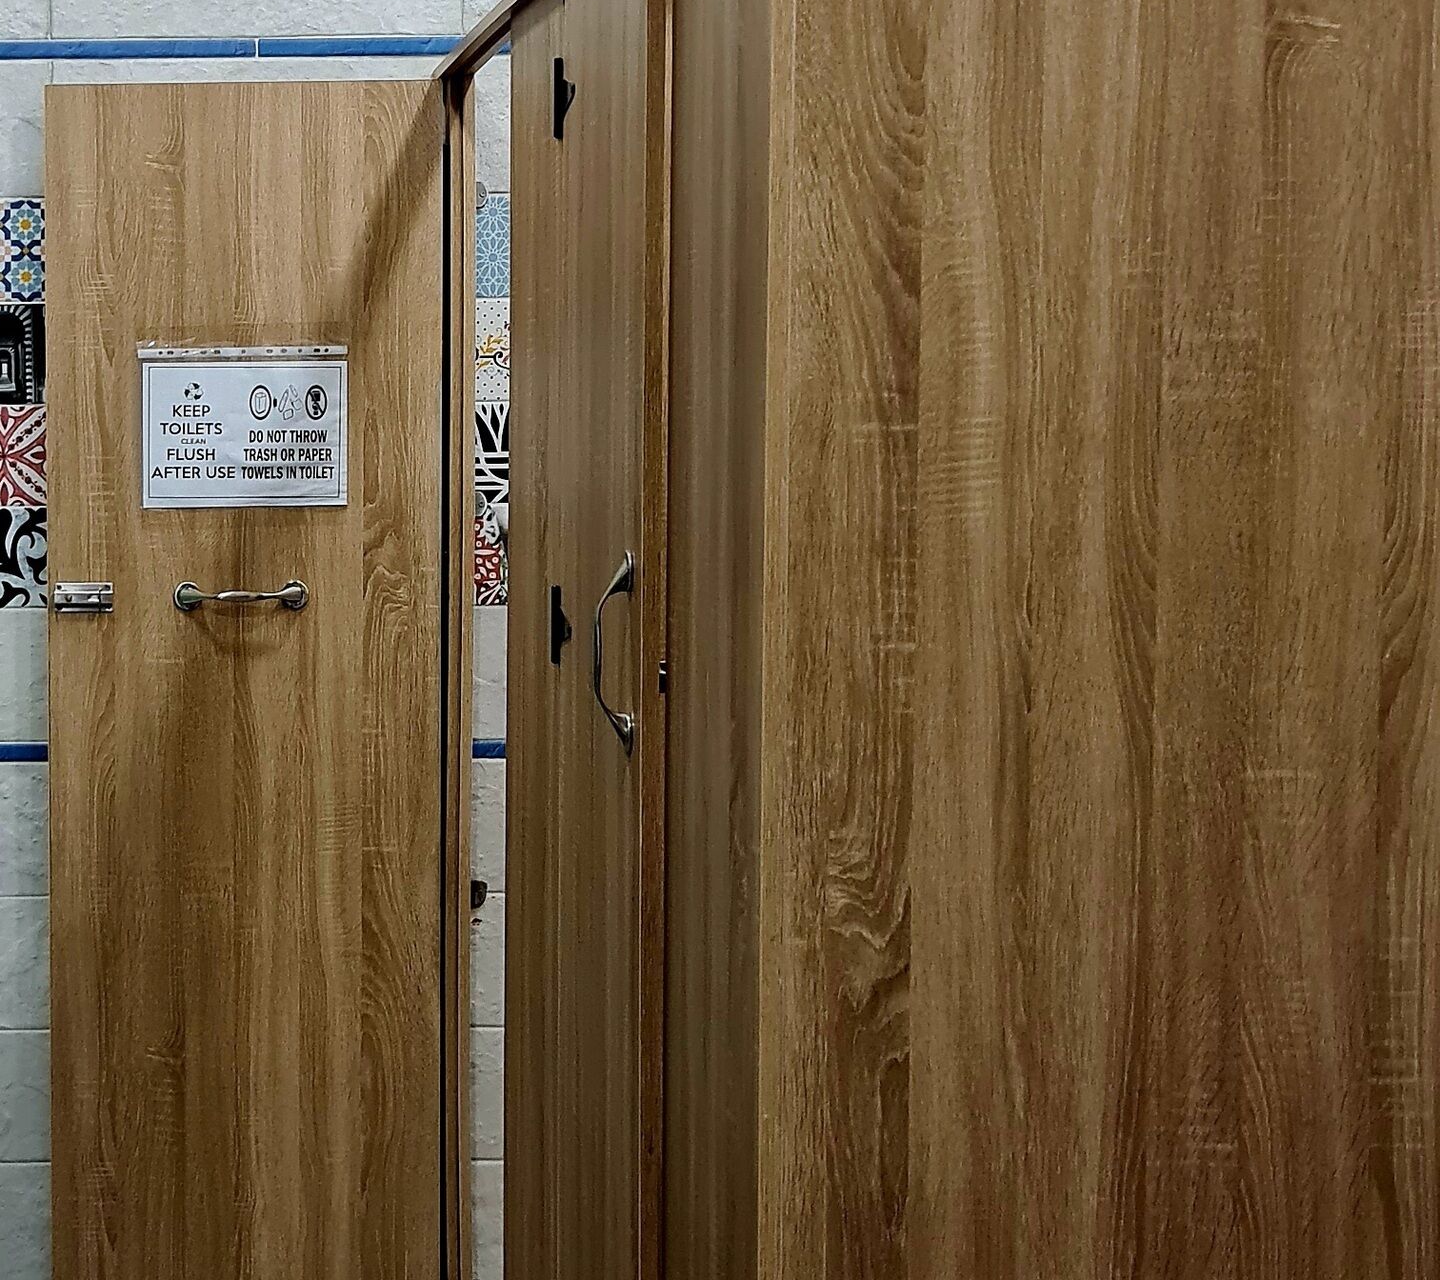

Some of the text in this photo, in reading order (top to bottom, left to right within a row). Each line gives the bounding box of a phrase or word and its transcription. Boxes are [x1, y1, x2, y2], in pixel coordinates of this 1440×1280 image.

[172, 404, 210, 417] KEEP
[160, 422, 222, 435] TOILETS
[249, 430, 328, 443] DO NOT THROW
[167, 448, 216, 461] FLUSH
[244, 448, 332, 462] TRASH OR PAPER
[151, 466, 236, 479] AFTER USE
[241, 466, 335, 480] TOWELS IN TOILET
